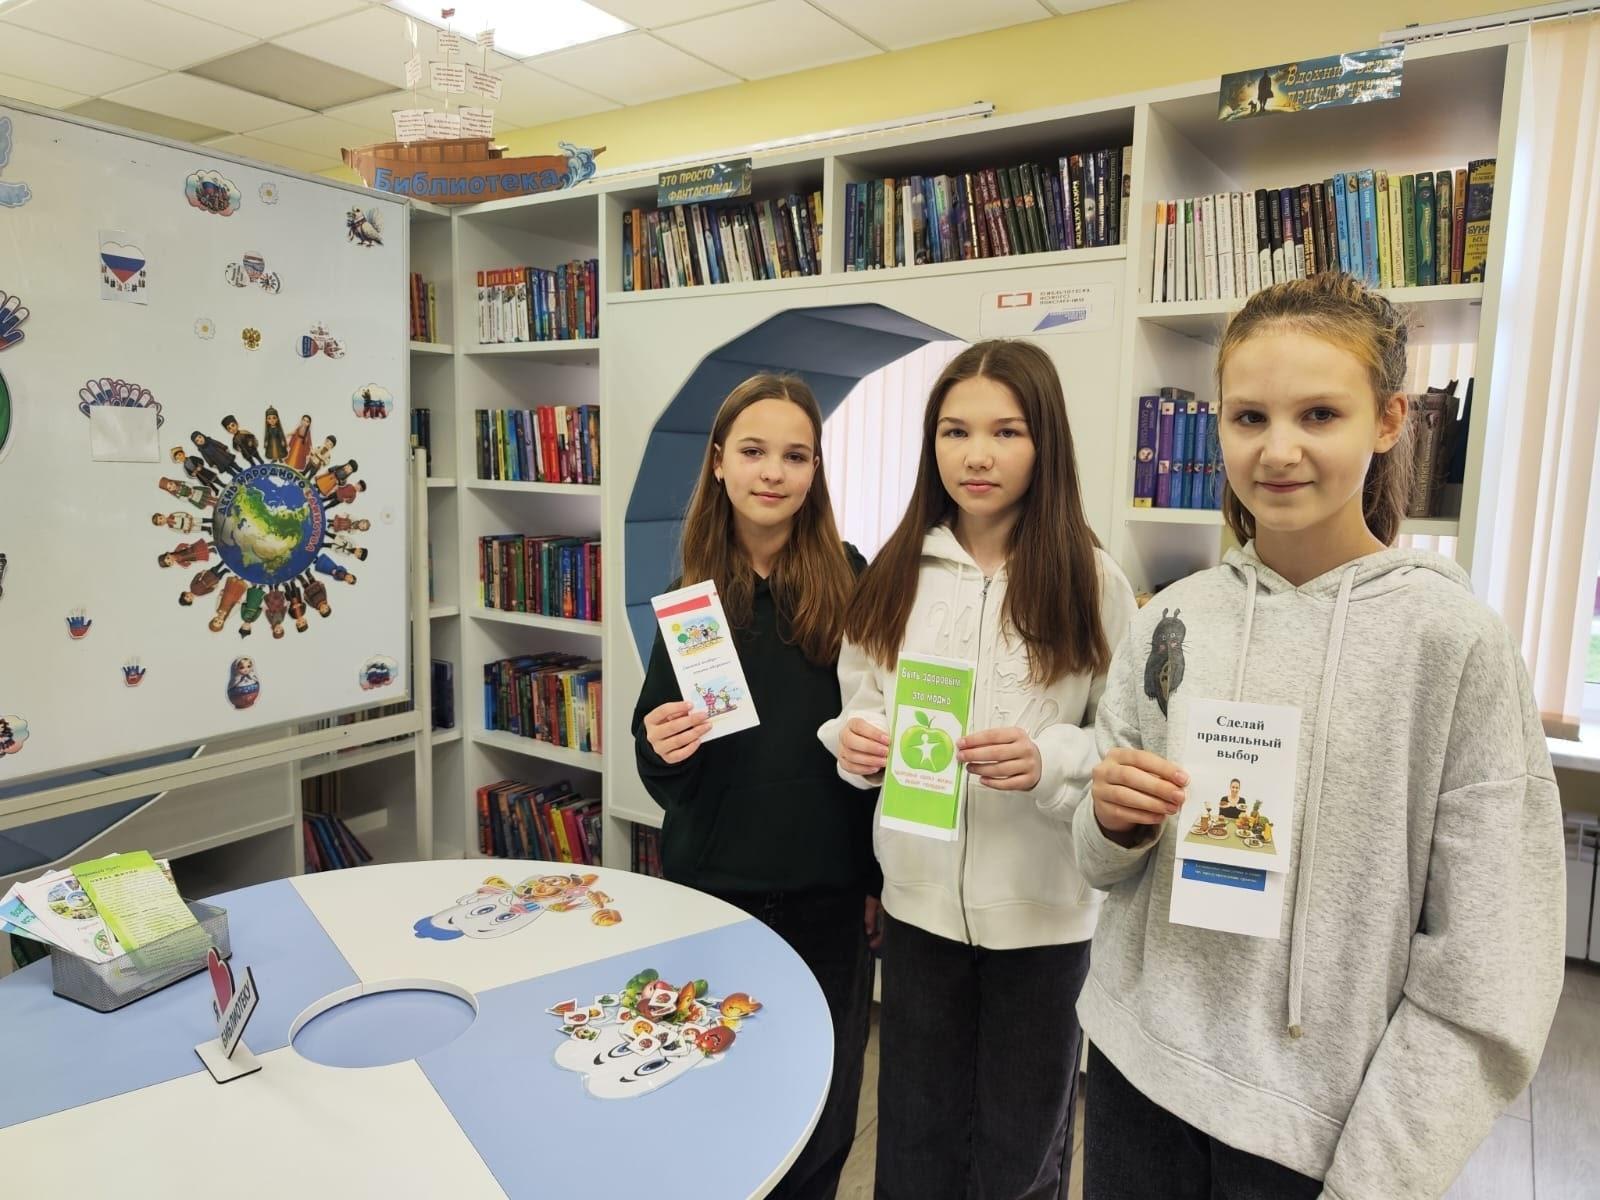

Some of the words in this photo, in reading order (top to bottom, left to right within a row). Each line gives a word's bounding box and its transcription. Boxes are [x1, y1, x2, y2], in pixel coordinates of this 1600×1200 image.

[374, 166, 559, 196] Библиотека
[660, 174, 677, 187] ЭТО
[679, 168, 715, 184] ПРОСТО
[218, 485, 238, 517] ДЕНЬ
[237, 467, 306, 489] НАРОДНОГО
[901, 668, 920, 681] Быть
[922, 674, 961, 687] здоровым
[912, 691, 925, 701] это
[927, 693, 952, 706] модно
[1216, 714, 1265, 731] Сделай
[1197, 731, 1283, 750] правильный
[1216, 748, 1260, 764] выбор
[221, 980, 251, 1050] БИБЛИОТЕКУ
